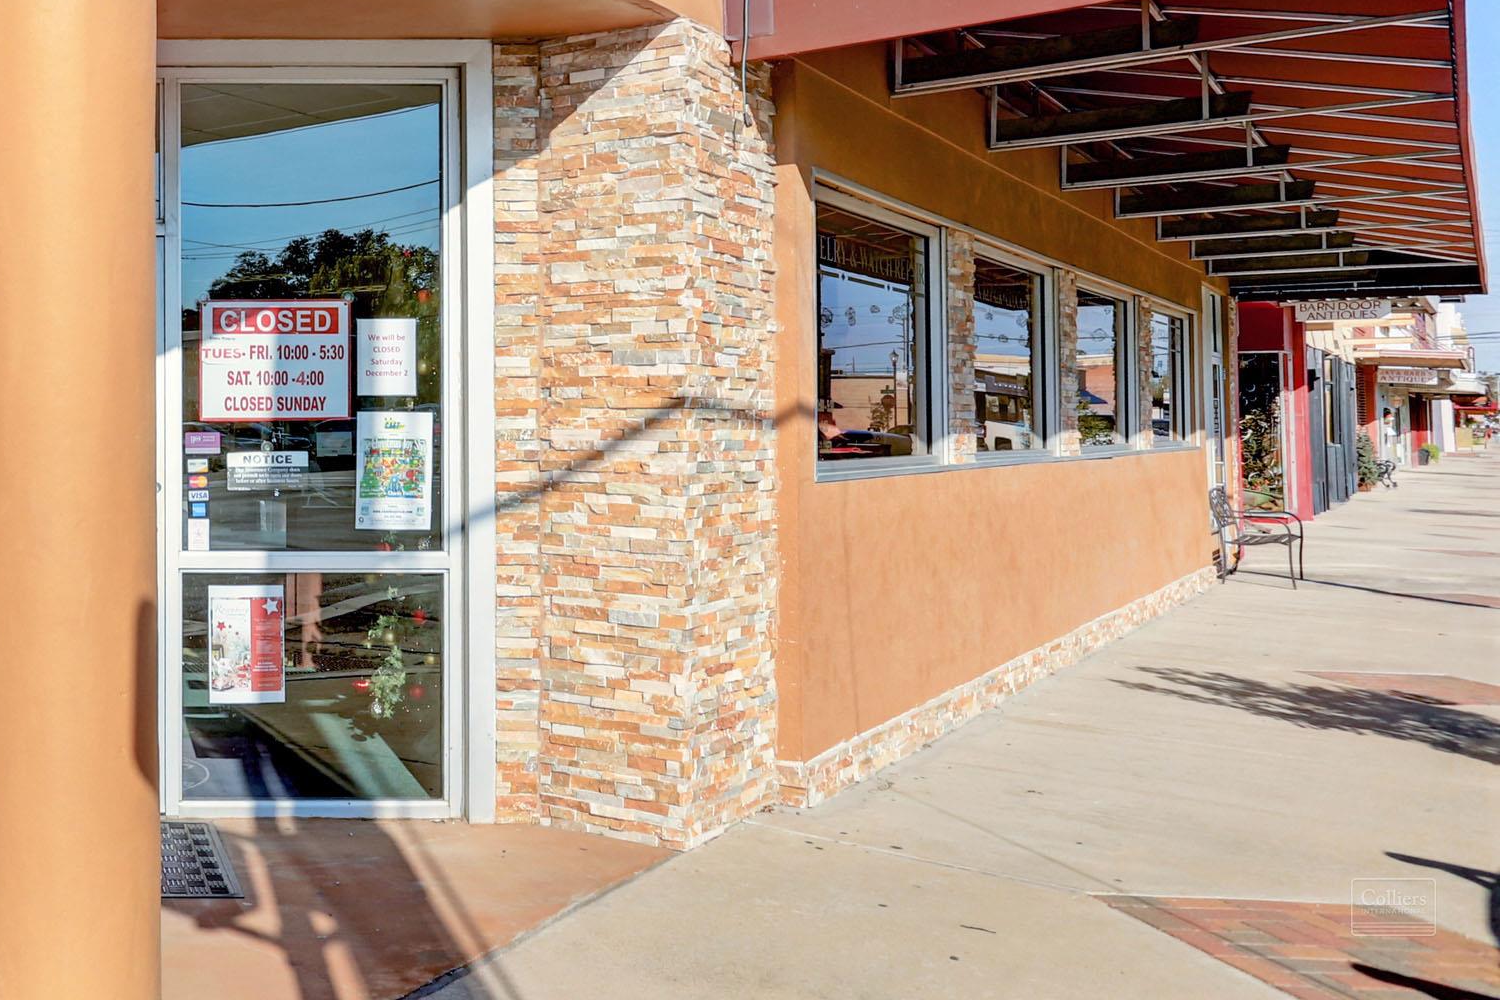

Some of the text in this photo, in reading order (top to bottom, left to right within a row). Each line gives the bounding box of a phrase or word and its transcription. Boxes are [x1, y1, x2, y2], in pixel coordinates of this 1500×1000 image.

[1299, 300, 1381, 312] BARN DOOR
[1306, 310, 1379, 320] ANTIQUES
[220, 310, 332, 332] CLOSED
[396, 333, 406, 341] be
[249, 345, 273, 360] FRI.
[276, 345, 309, 360] 10:00
[319, 345, 345, 360] 5:30
[371, 358, 404, 367] Saturday
[226, 371, 252, 385] SAT.
[256, 371, 289, 385] 10:00
[224, 396, 327, 411] CLOSED SUNDAY
[243, 454, 293, 464] NOTICE
[190, 491, 208, 499] VISA
